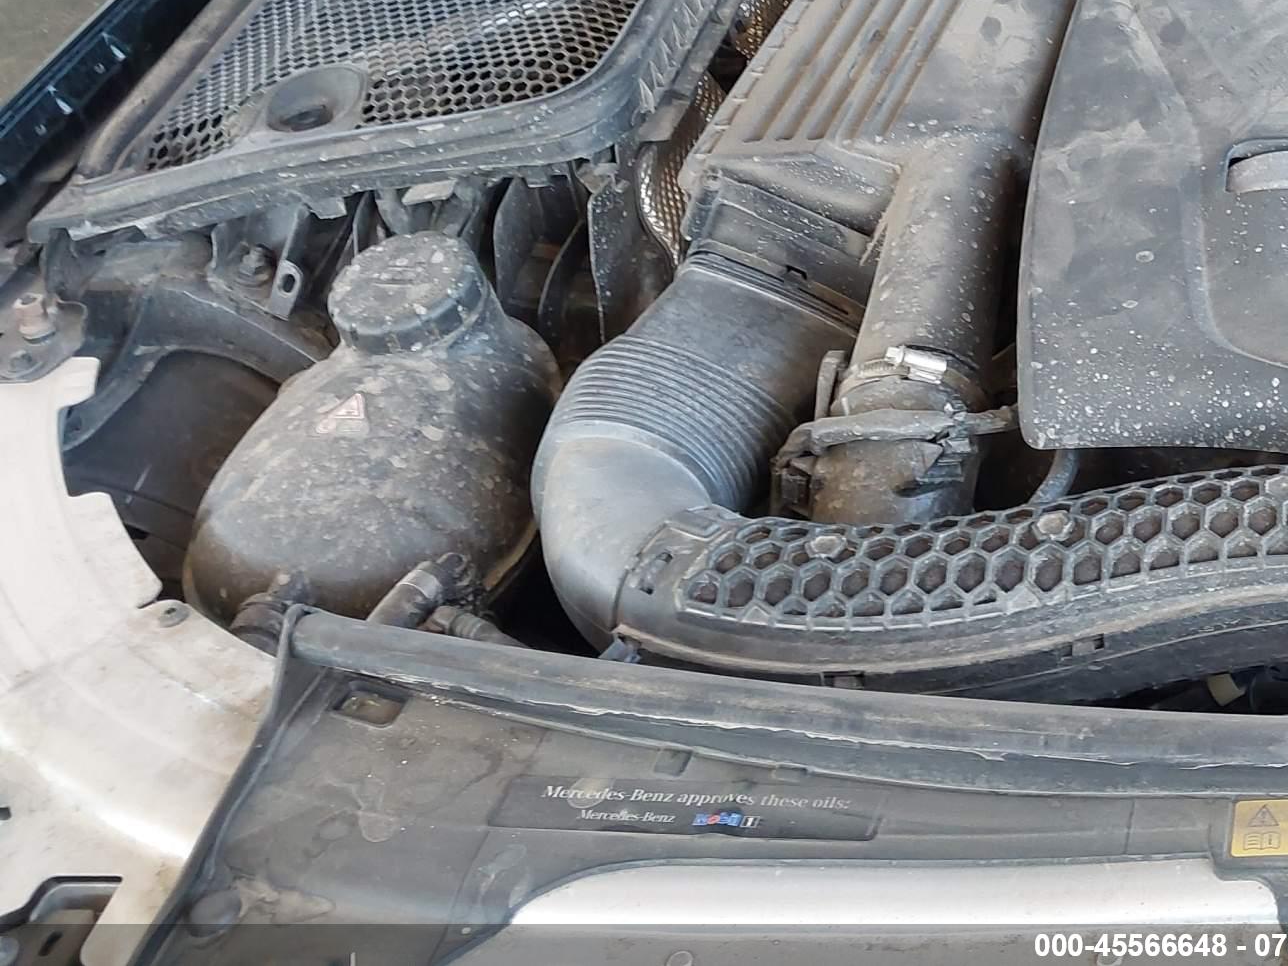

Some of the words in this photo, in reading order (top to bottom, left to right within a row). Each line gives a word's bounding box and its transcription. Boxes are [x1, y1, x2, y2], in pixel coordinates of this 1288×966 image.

[541, 785, 675, 803] Mercedes-Benz
[676, 792, 755, 807] approves
[760, 794, 809, 808] these
[812, 796, 852, 810] oils:
[576, 809, 676, 824] Mercedes-Benz
